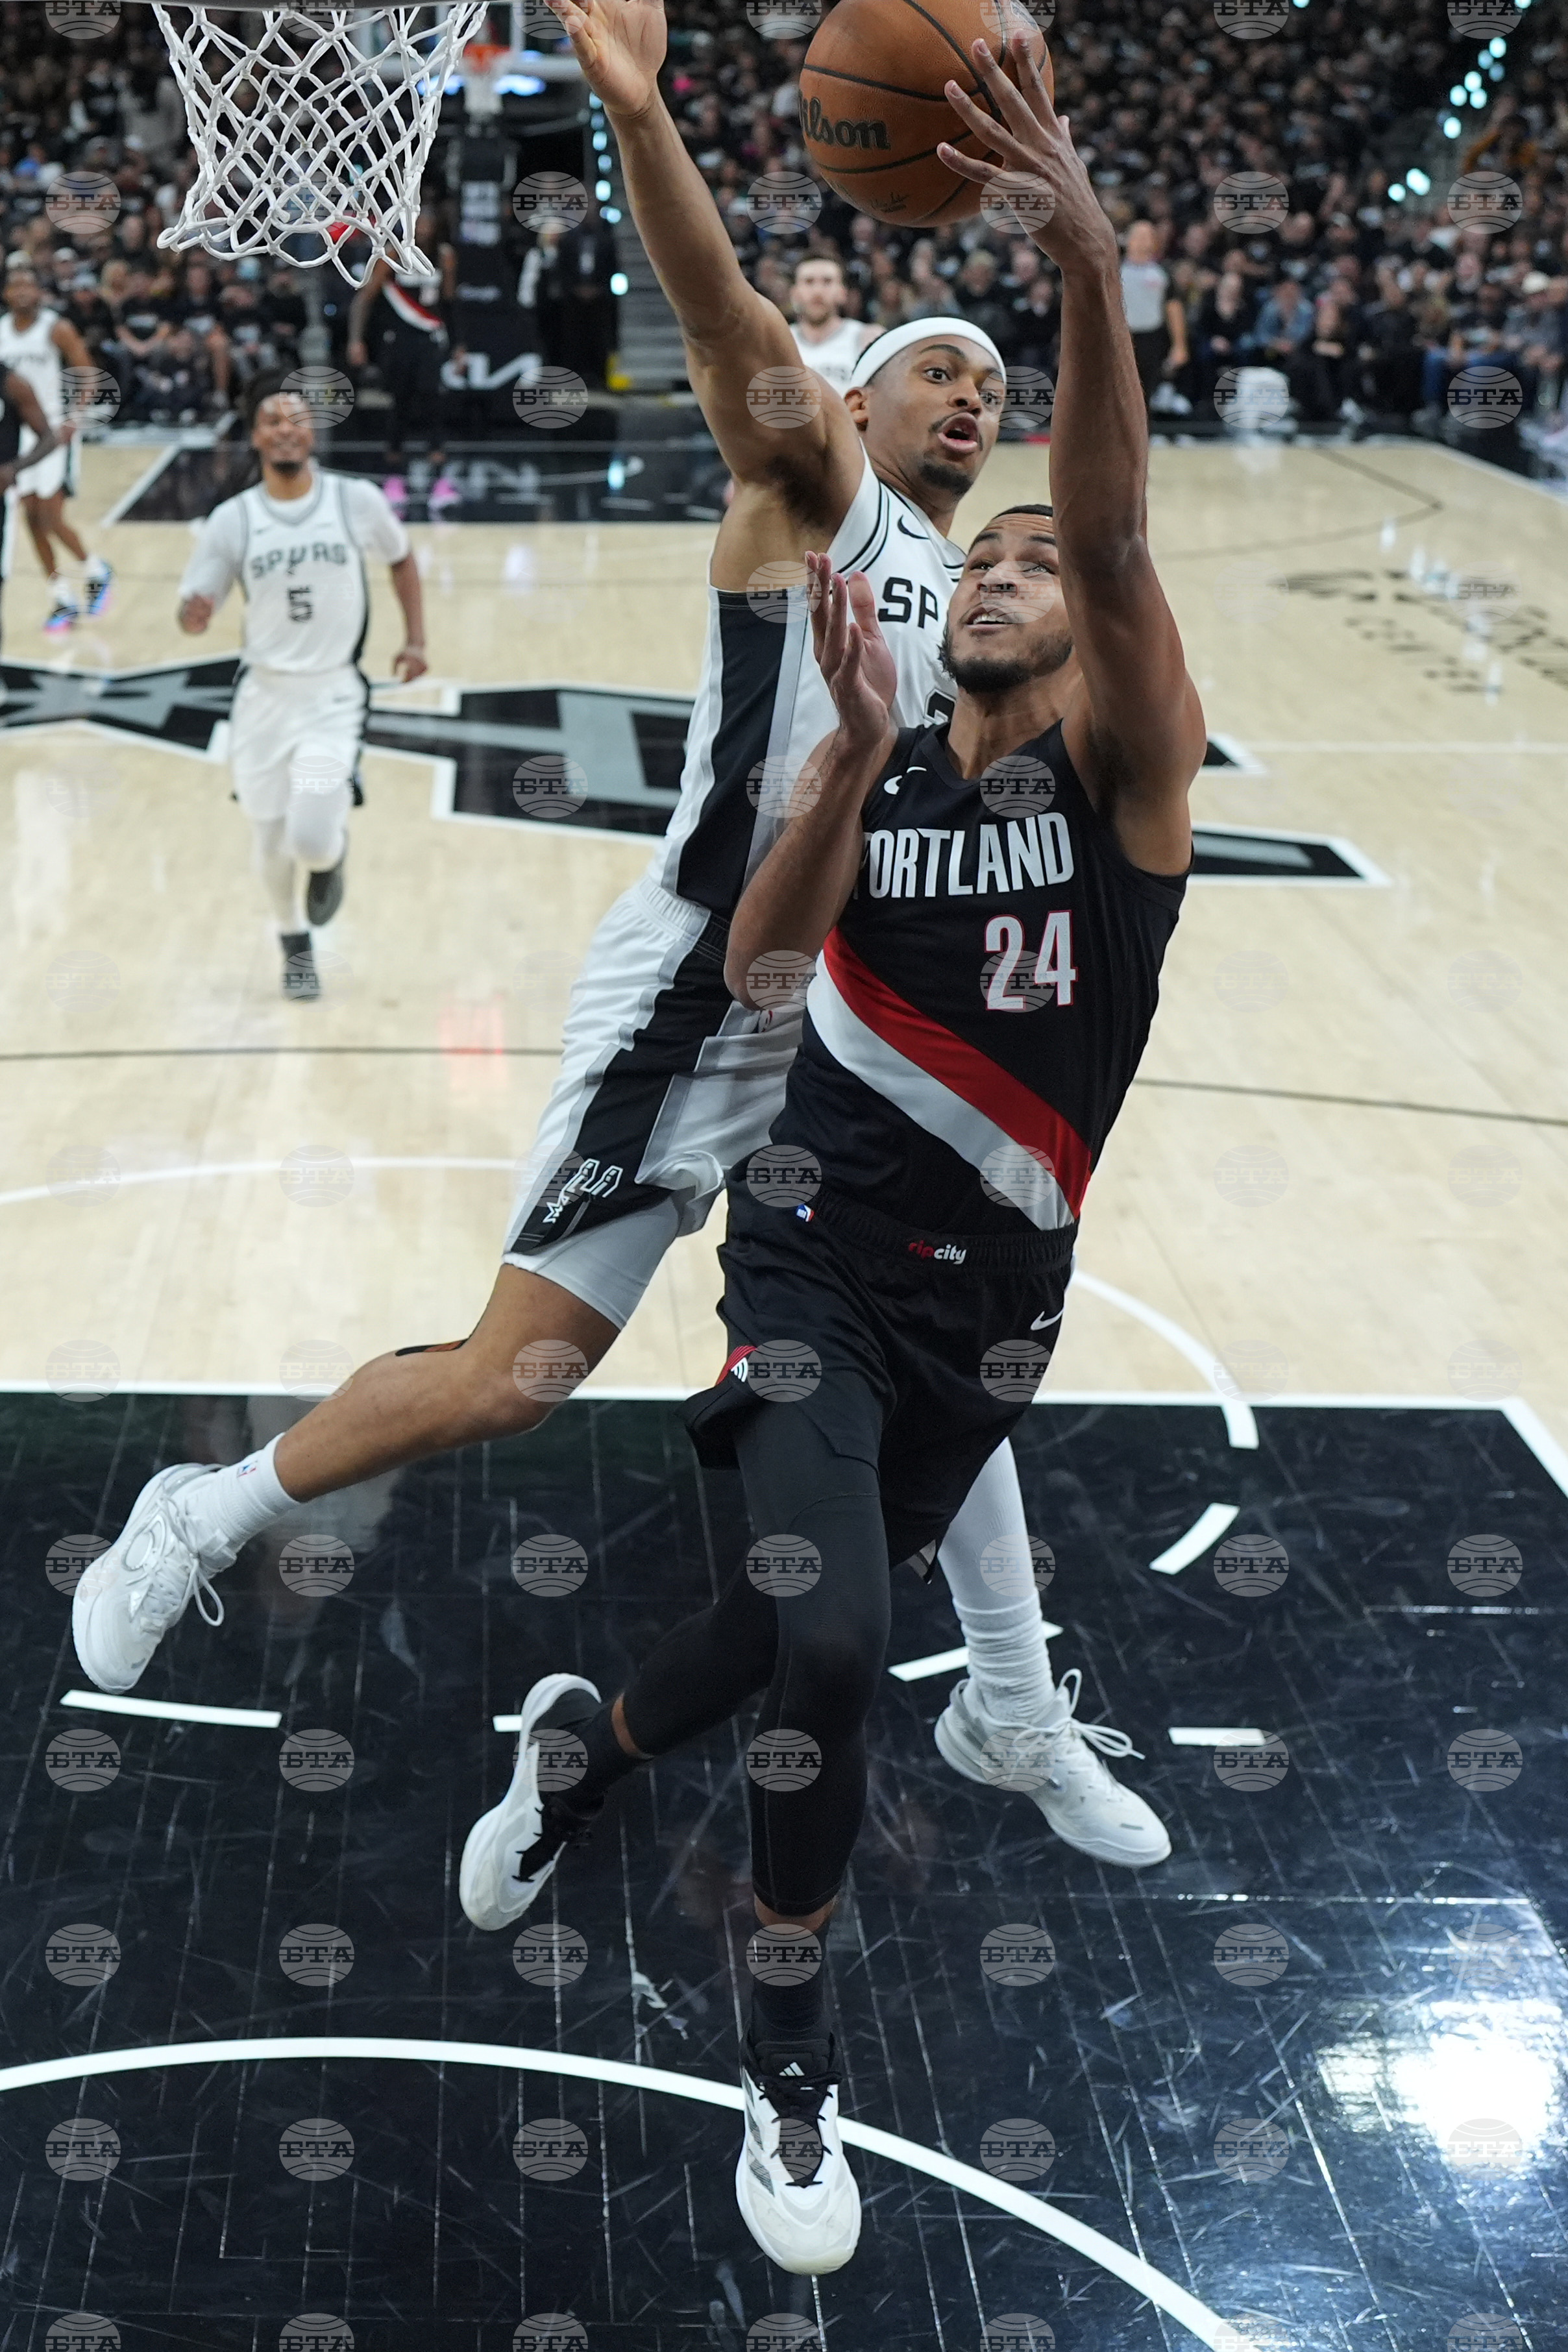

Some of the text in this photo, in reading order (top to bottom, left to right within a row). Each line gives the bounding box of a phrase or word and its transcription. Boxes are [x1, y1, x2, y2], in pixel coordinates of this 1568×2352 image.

[798, 90, 890, 149] ilson
[288, 586, 313, 622] 5
[878, 576, 939, 629] SP
[985, 910, 1078, 1011] 24
